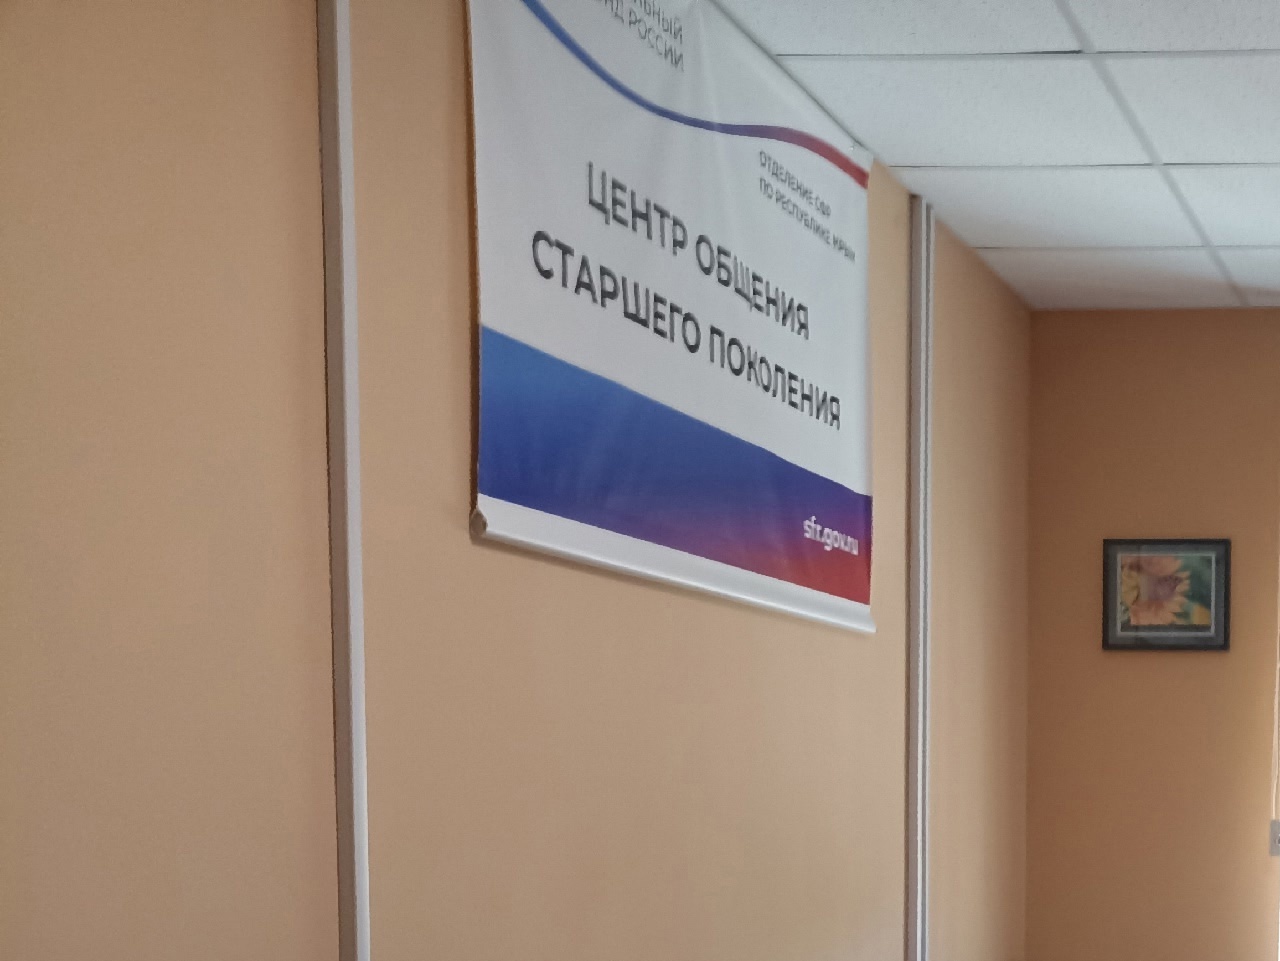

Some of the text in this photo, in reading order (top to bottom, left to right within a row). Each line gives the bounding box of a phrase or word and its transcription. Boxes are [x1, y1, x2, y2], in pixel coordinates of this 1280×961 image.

[629, 7, 684, 73] РОССИИ
[760, 151, 813, 206] ОТДЕЛЕНИЕ
[760, 177, 773, 200] ПО
[776, 190, 830, 245] РЕСПУБЛИКЕ
[588, 161, 809, 340] ЦЕНТР ОБЩЕНИЯ
[532, 231, 841, 431] СТАРШЕГО ПОКОЛЕНИЯ
